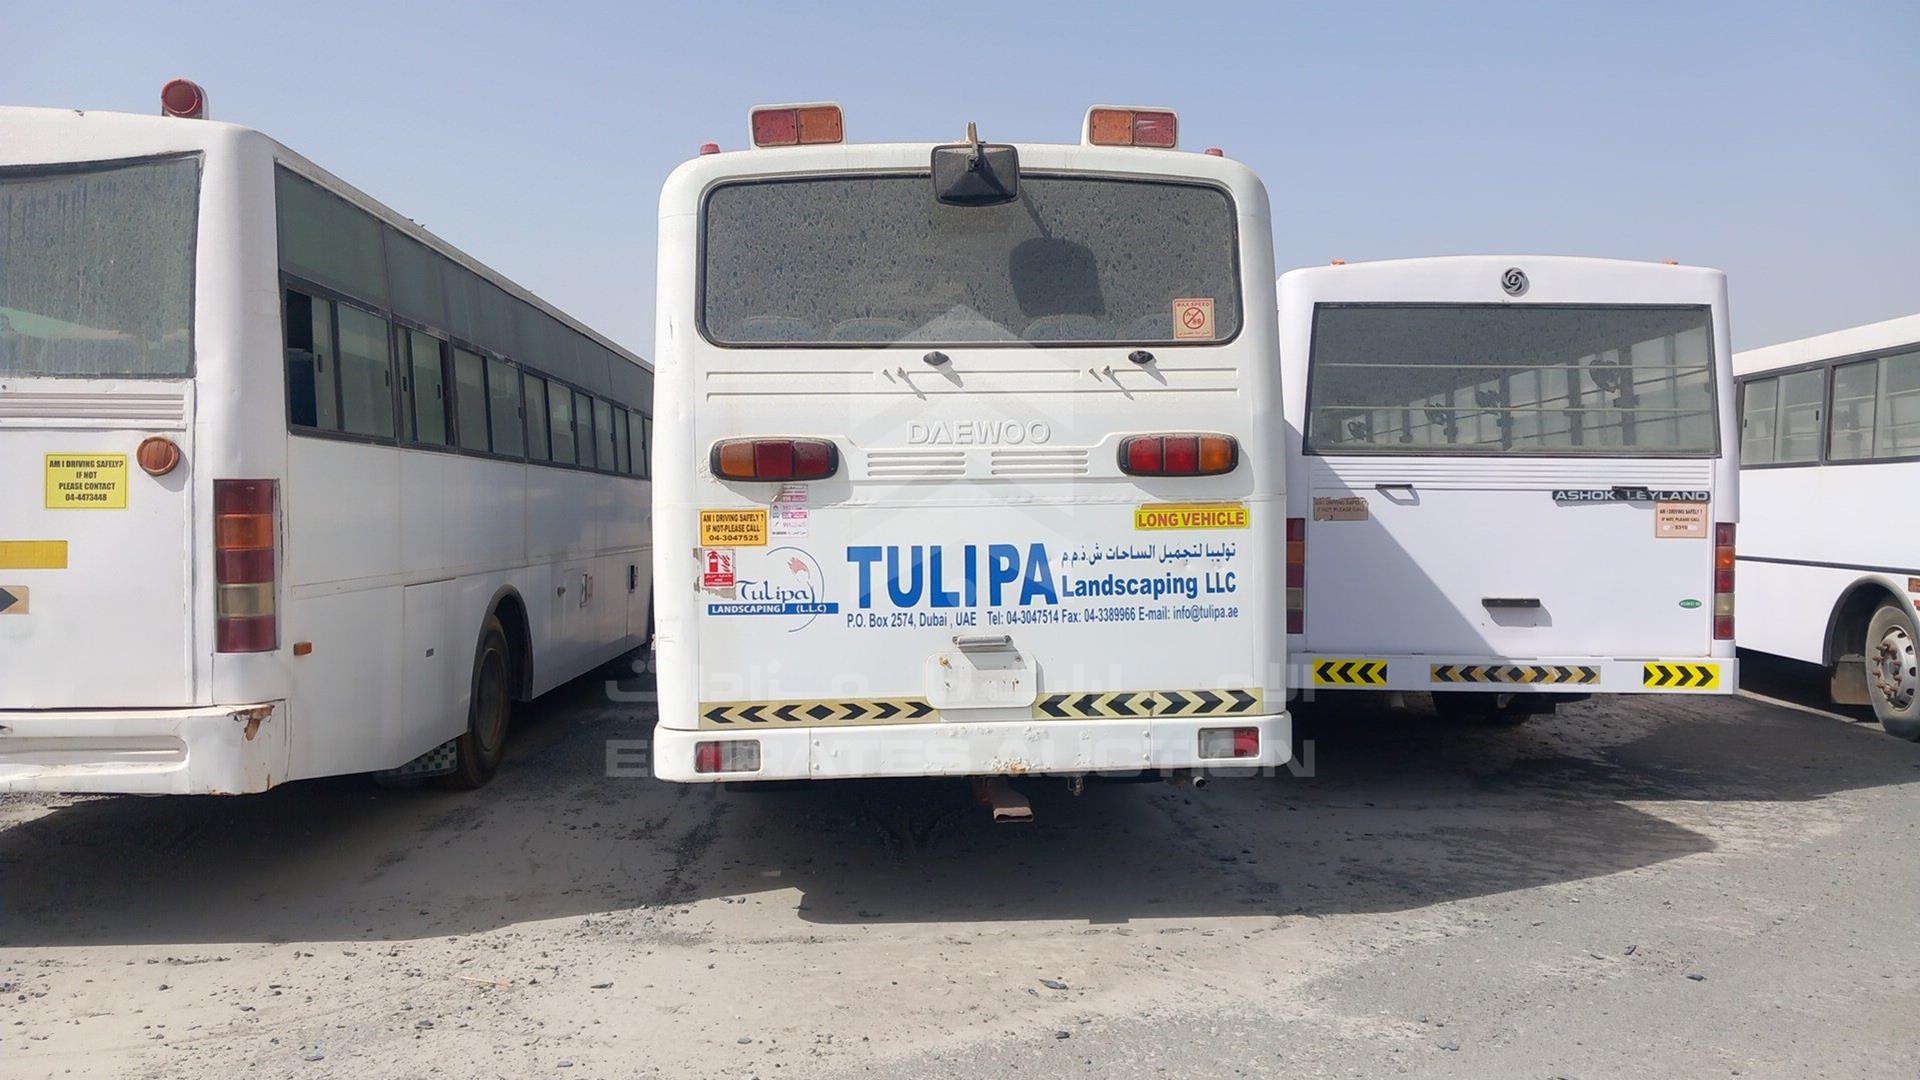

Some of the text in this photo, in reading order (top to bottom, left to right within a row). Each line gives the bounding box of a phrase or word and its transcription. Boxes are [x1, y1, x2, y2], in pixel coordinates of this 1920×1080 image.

[906, 419, 1051, 445] DAEWOO
[49, 460, 124, 468] AM I DRIVING SAFELY?
[76, 471, 97, 479] IF NOT
[58, 482, 115, 490] PLEASE CONTACT
[1555, 491, 1709, 501] ASHOK LEYLAND
[703, 514, 711, 522] AM
[716, 514, 738, 522] DRIVING
[739, 513, 759, 522] SAFELY
[1138, 511, 1244, 527] LONG VEHICLE
[706, 524, 711, 532] IF
[745, 524, 760, 532] CALL
[1106, 543, 1155, 560] الساحات
[1159, 543, 1202, 564] لتجميل
[846, 543, 1058, 608] TULIPA
[1061, 571, 1237, 600] Landscaping LLC
[735, 580, 816, 612] Tulipa
[711, 604, 781, 614] LANDSCAPING
[846, 613, 866, 627] P.O.
[869, 613, 889, 627] Box
[891, 612, 917, 629] 2574,
[919, 611, 948, 627] Dubai
[955, 611, 977, 626] UAE
[987, 610, 1004, 625] Tel:
[1006, 609, 1059, 625] 04-3047514
[1061, 608, 1082, 623] Fax:
[1084, 607, 1136, 622] 04-3389966
[1138, 606, 1171, 621] E-mail:
[1173, 604, 1239, 622] info@tulipa.ae
